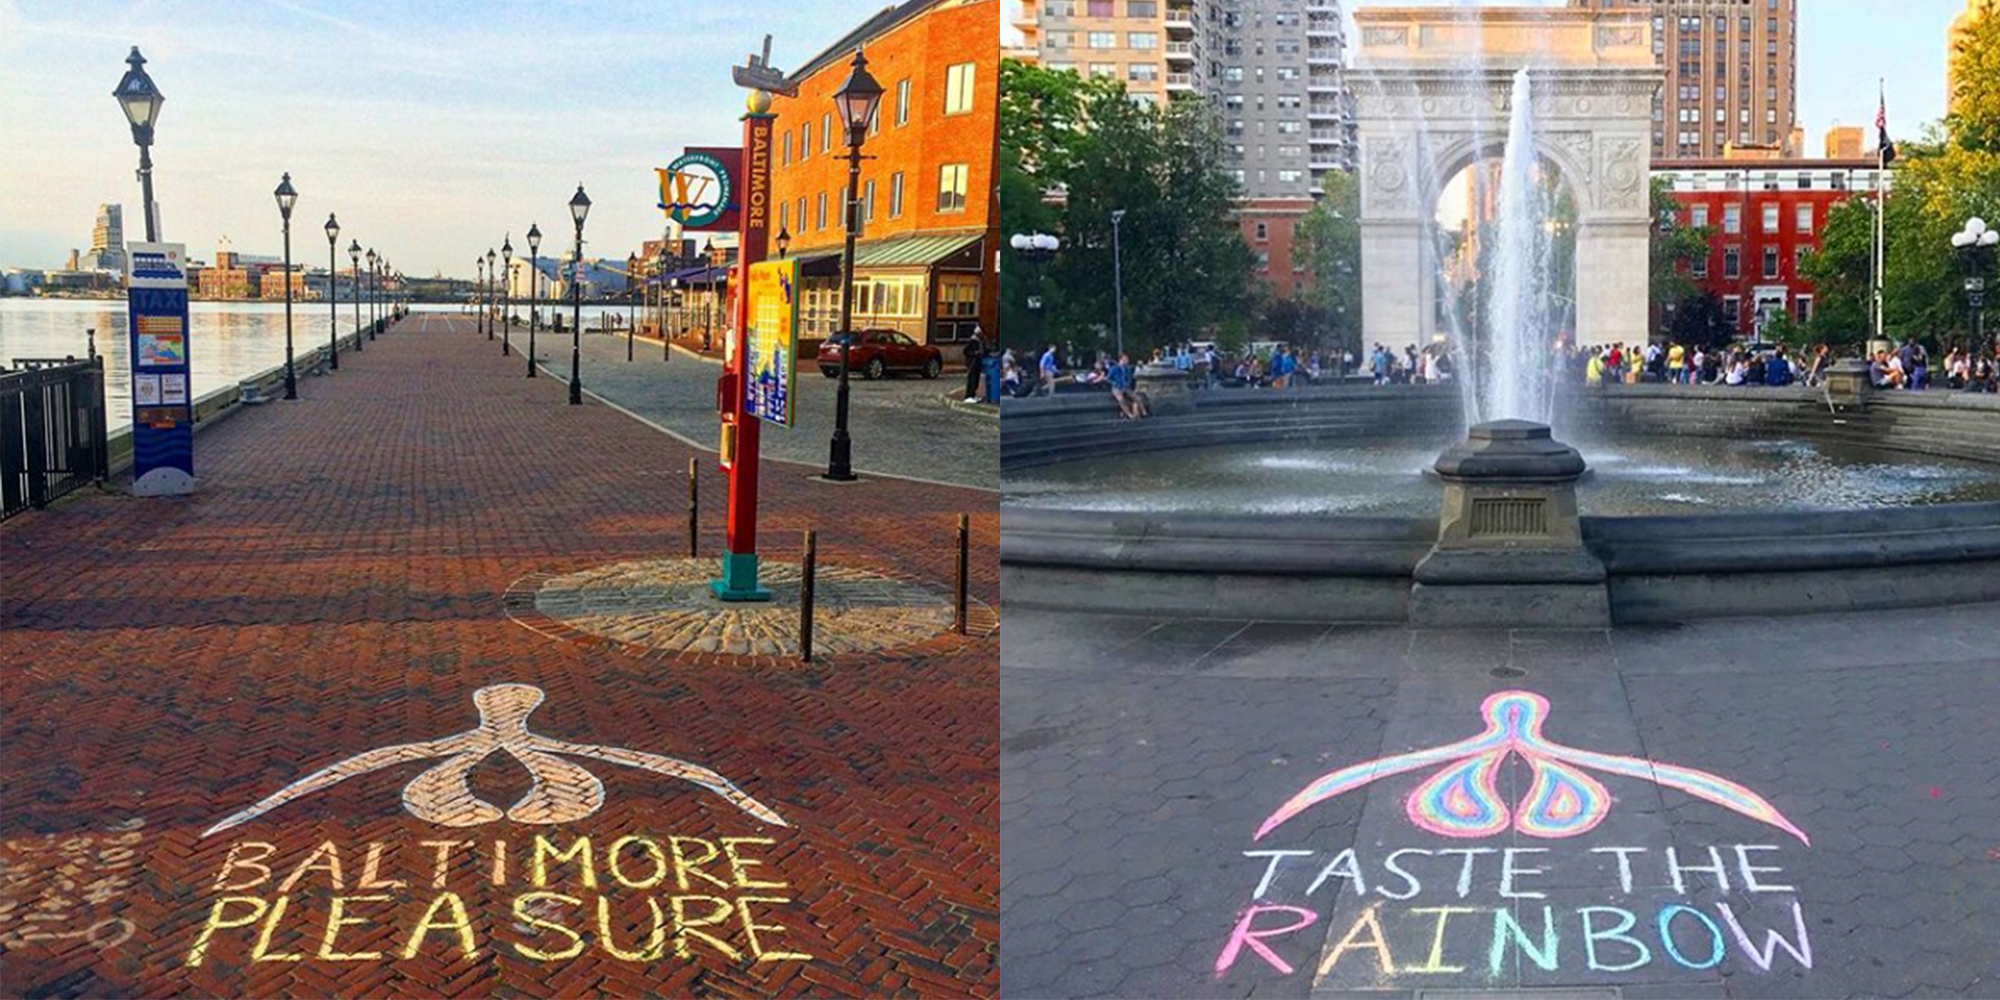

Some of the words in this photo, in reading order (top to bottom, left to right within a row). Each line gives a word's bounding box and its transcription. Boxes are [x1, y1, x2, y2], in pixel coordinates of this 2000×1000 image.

[749, 126, 769, 229] BALTIMORE
[134, 290, 185, 309] TAXI
[212, 834, 788, 892] BALTIMORE
[1242, 847, 1549, 900] TASTE
[1590, 843, 1796, 895] THE
[185, 891, 814, 967] PLEASURE
[1213, 900, 1813, 980] RAINBOW
